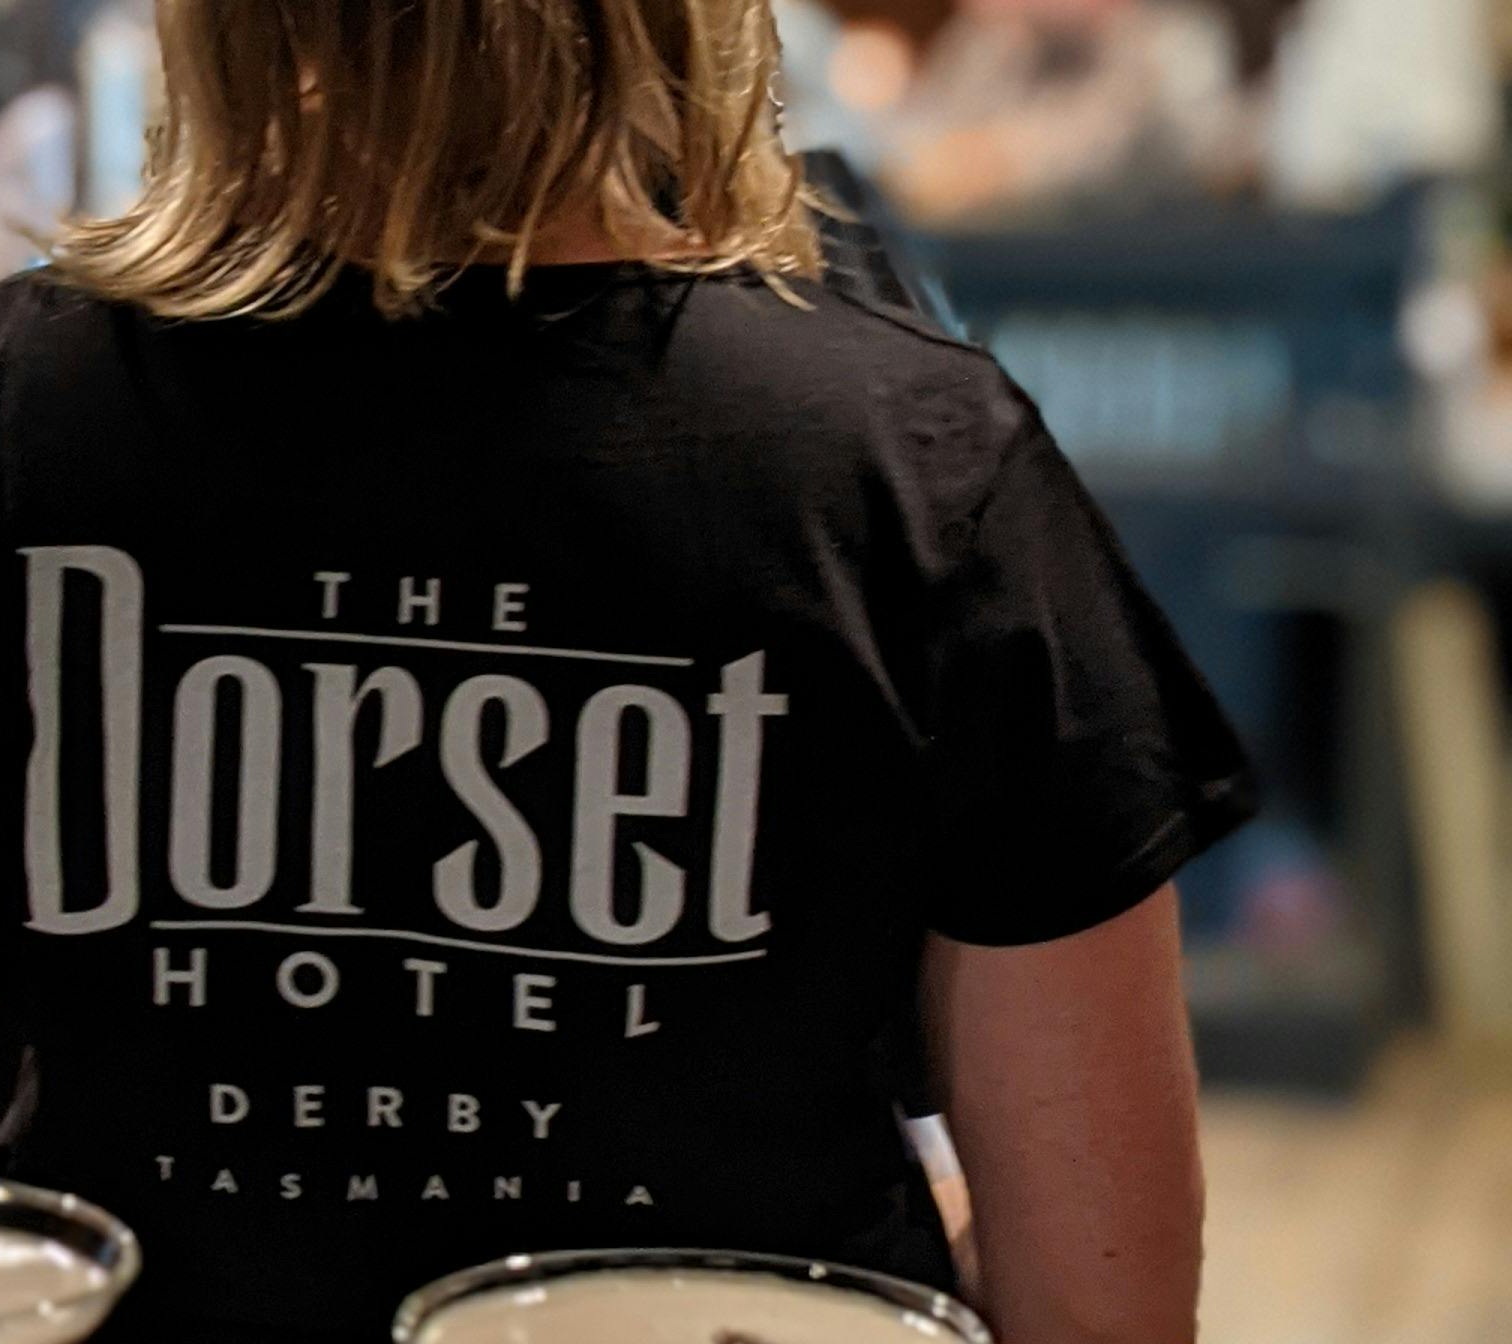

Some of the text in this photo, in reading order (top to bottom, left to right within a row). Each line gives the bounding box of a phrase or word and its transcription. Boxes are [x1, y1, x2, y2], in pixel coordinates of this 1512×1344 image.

[315, 570, 532, 632] THE
[18, 544, 790, 947] Dorset
[151, 947, 662, 1039] HOTEL
[210, 1083, 564, 1140] DERBY
[154, 1154, 656, 1207] TASMANIA
